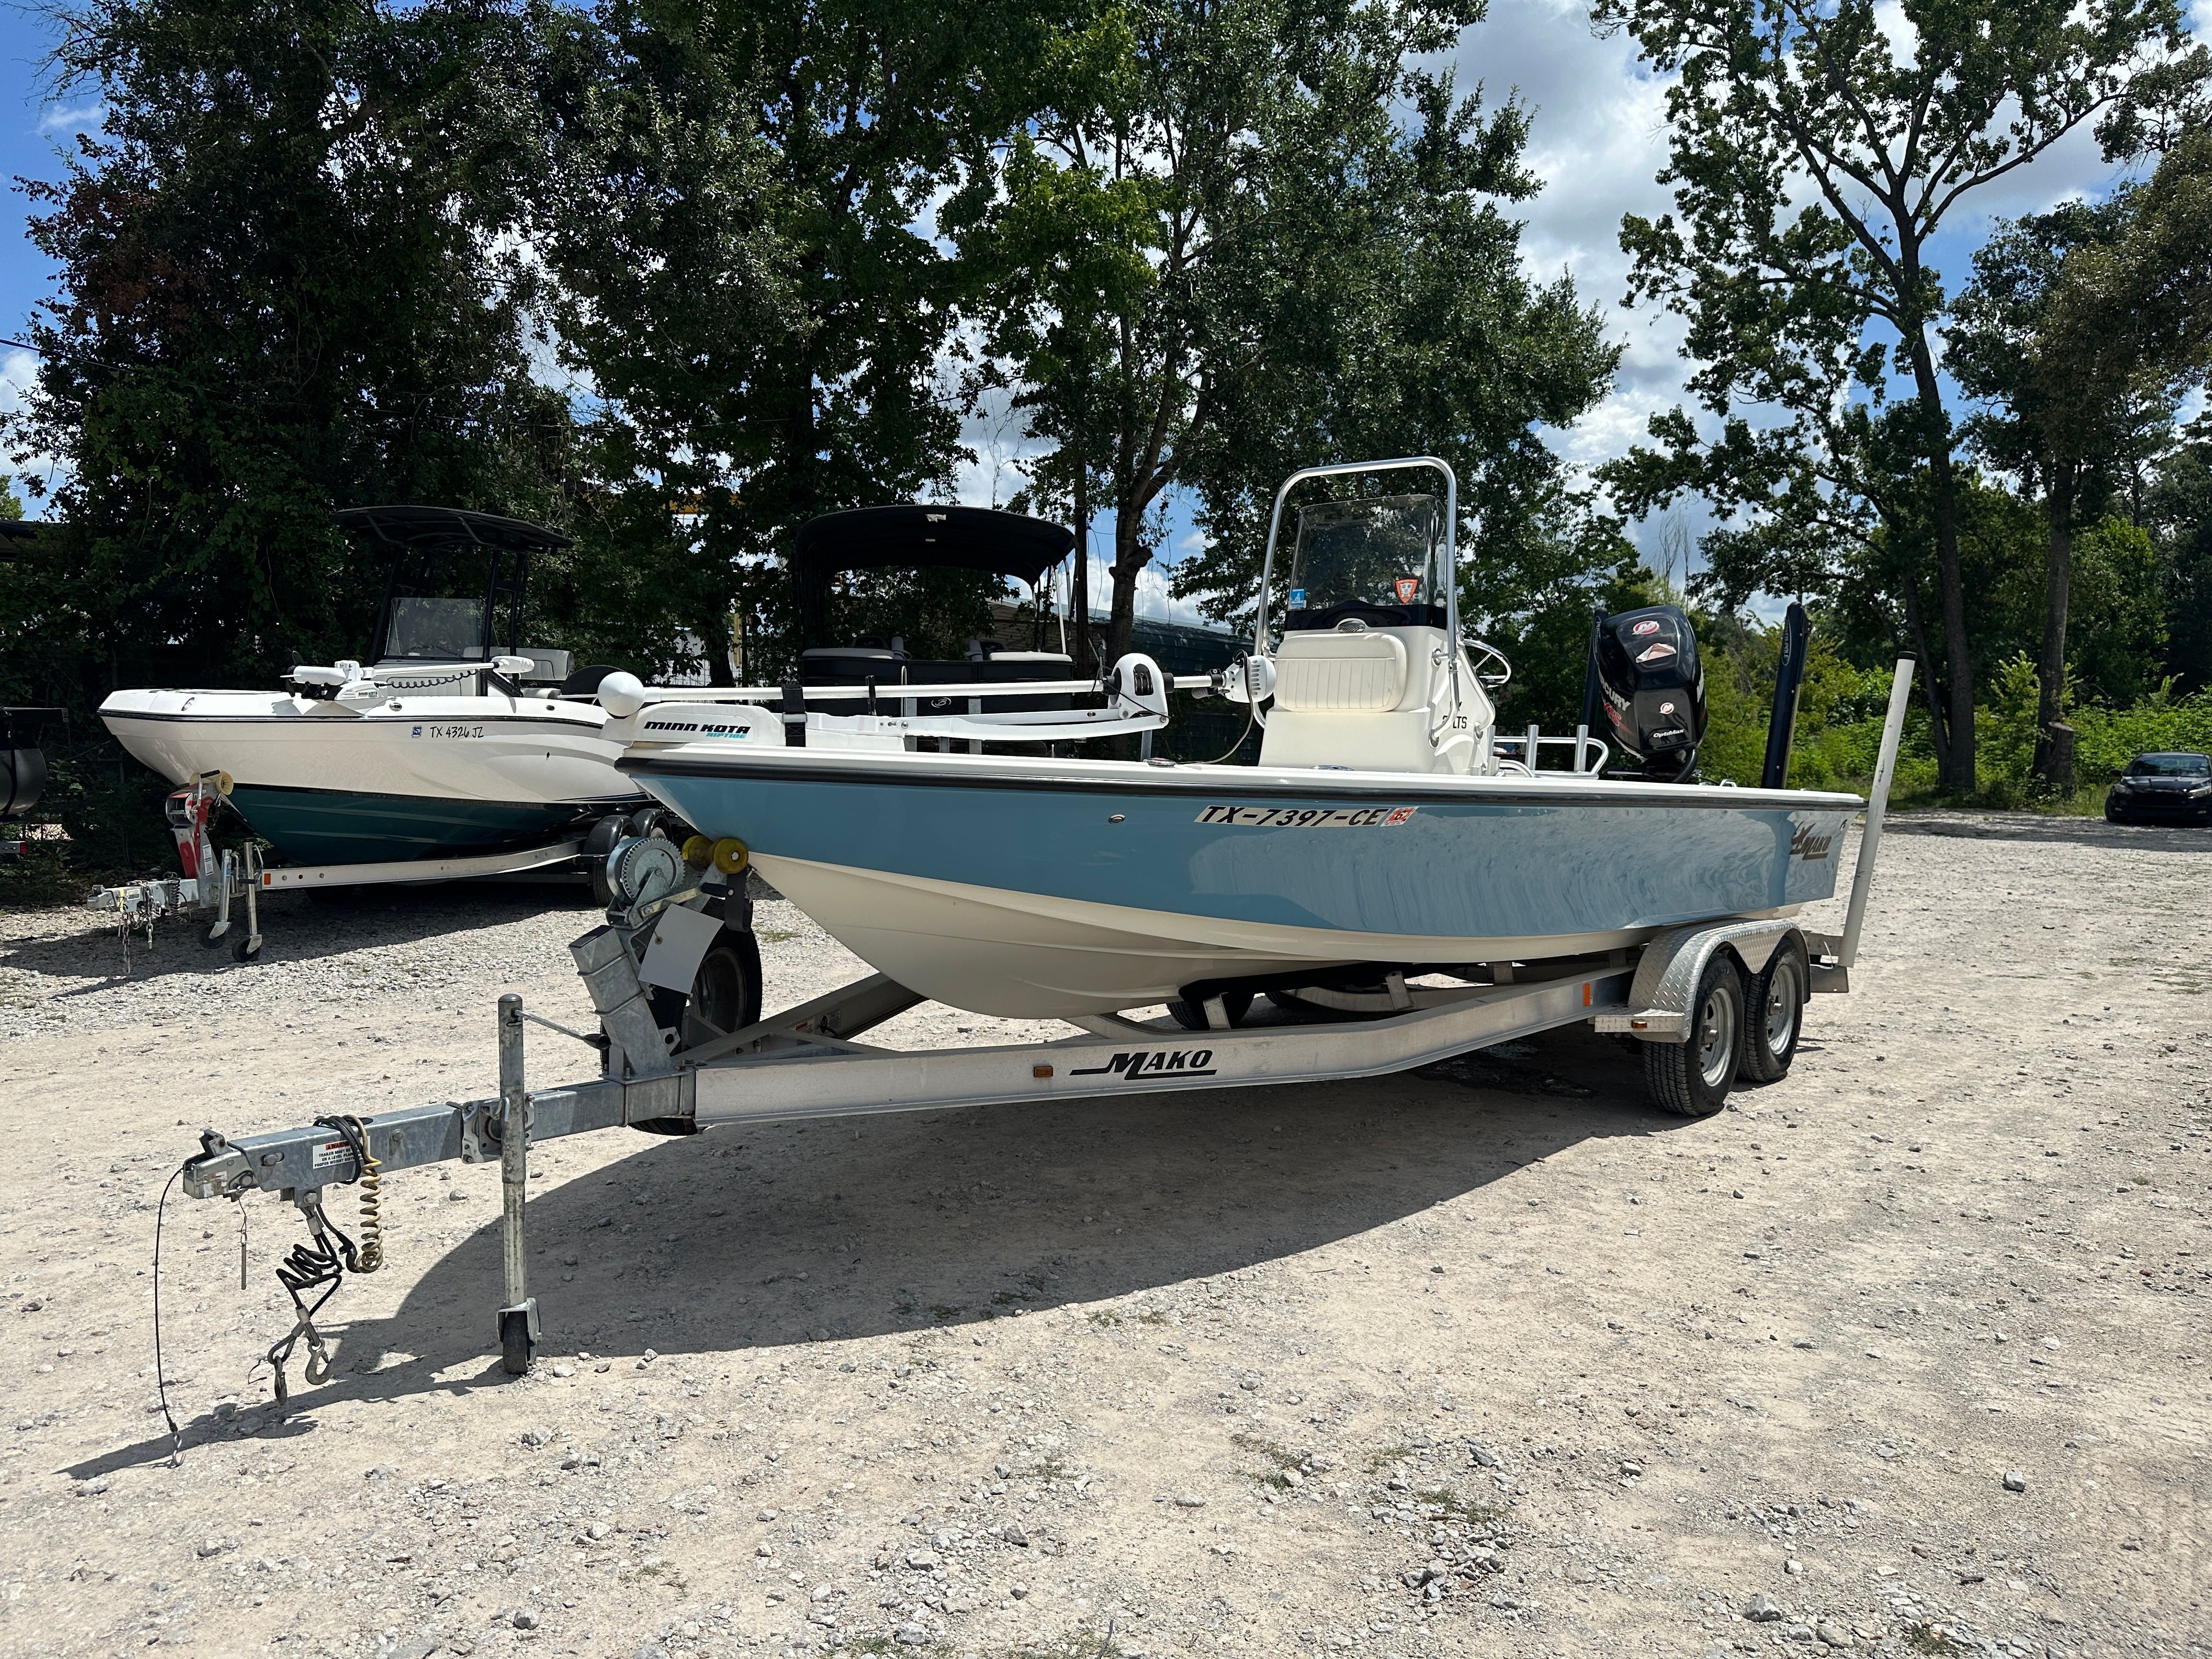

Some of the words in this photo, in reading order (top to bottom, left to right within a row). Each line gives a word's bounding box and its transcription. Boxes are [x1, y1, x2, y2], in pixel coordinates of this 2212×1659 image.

[430, 726, 443, 738] TX
[446, 726, 470, 738] 4326
[472, 727, 484, 738] JZ
[644, 721, 698, 731] MINN
[700, 724, 751, 734] KOTA
[1653, 729, 1685, 738] OptiMax
[1201, 806, 1389, 826] TX-7397-CE
[1796, 836, 1831, 860] MAKO
[1104, 1049, 1217, 1080] MAKO
